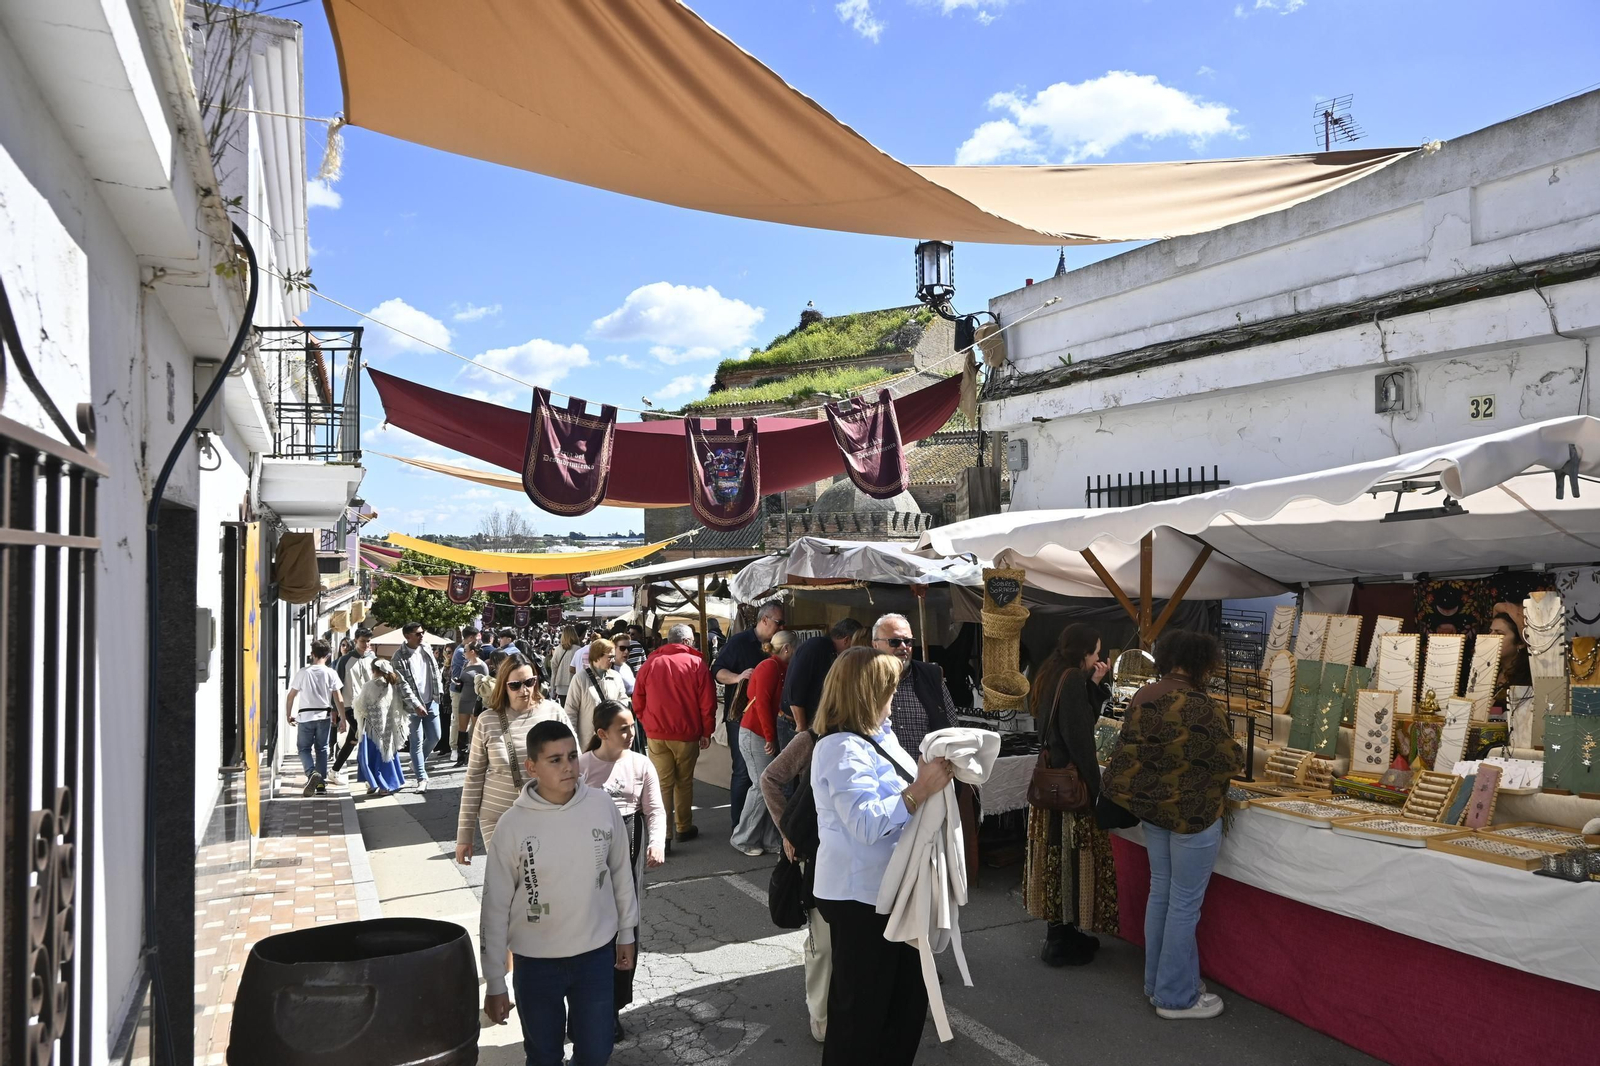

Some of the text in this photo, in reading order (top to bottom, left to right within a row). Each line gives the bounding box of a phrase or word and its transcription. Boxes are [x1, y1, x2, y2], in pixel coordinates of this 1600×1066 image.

[1470, 397, 1494, 419] 32
[526, 840, 535, 865] BEST
[523, 859, 534, 905] ALWAYS
[530, 868, 539, 889] YOUR
